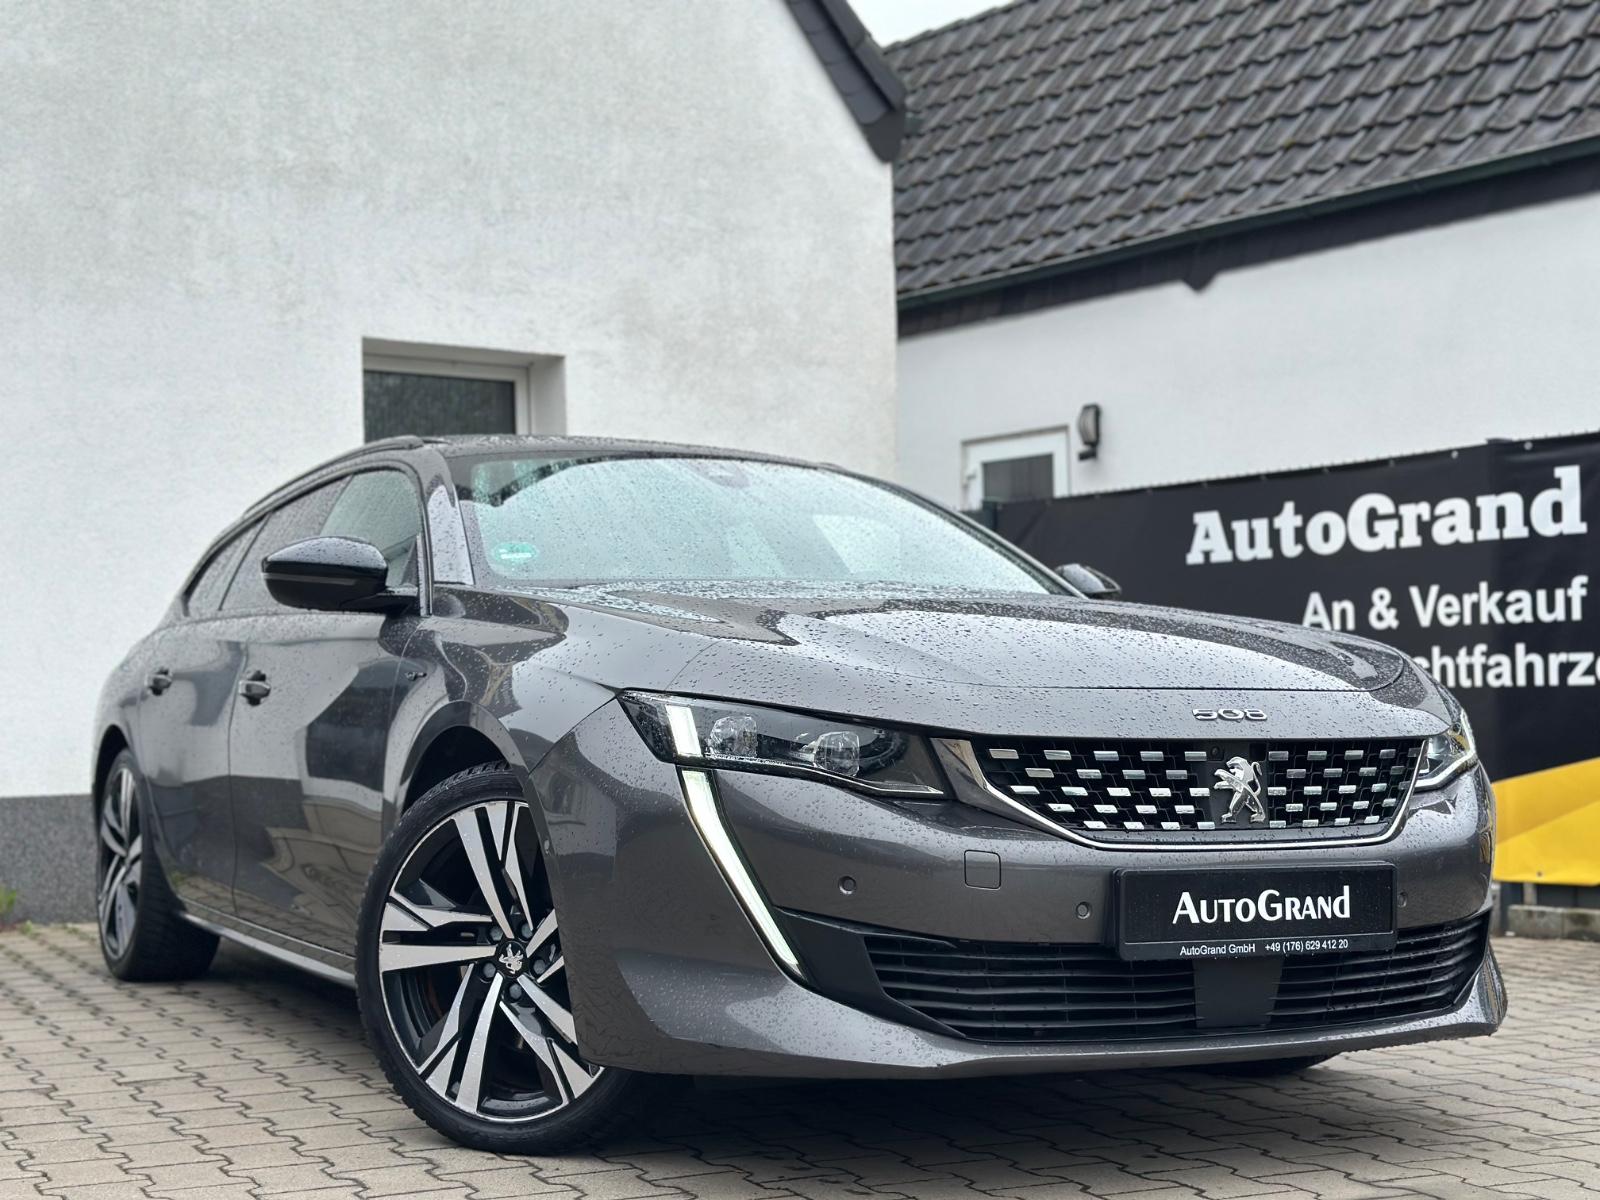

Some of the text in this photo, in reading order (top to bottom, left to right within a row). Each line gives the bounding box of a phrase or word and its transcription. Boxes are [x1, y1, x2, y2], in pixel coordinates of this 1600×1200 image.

[1186, 465, 1588, 565] AutoGrand
[1302, 575, 1589, 631] An & Verkauf
[1192, 708, 1268, 721] 508
[1179, 938, 1349, 956] AutoGrand GmbH +49 (176) 629 412 20
